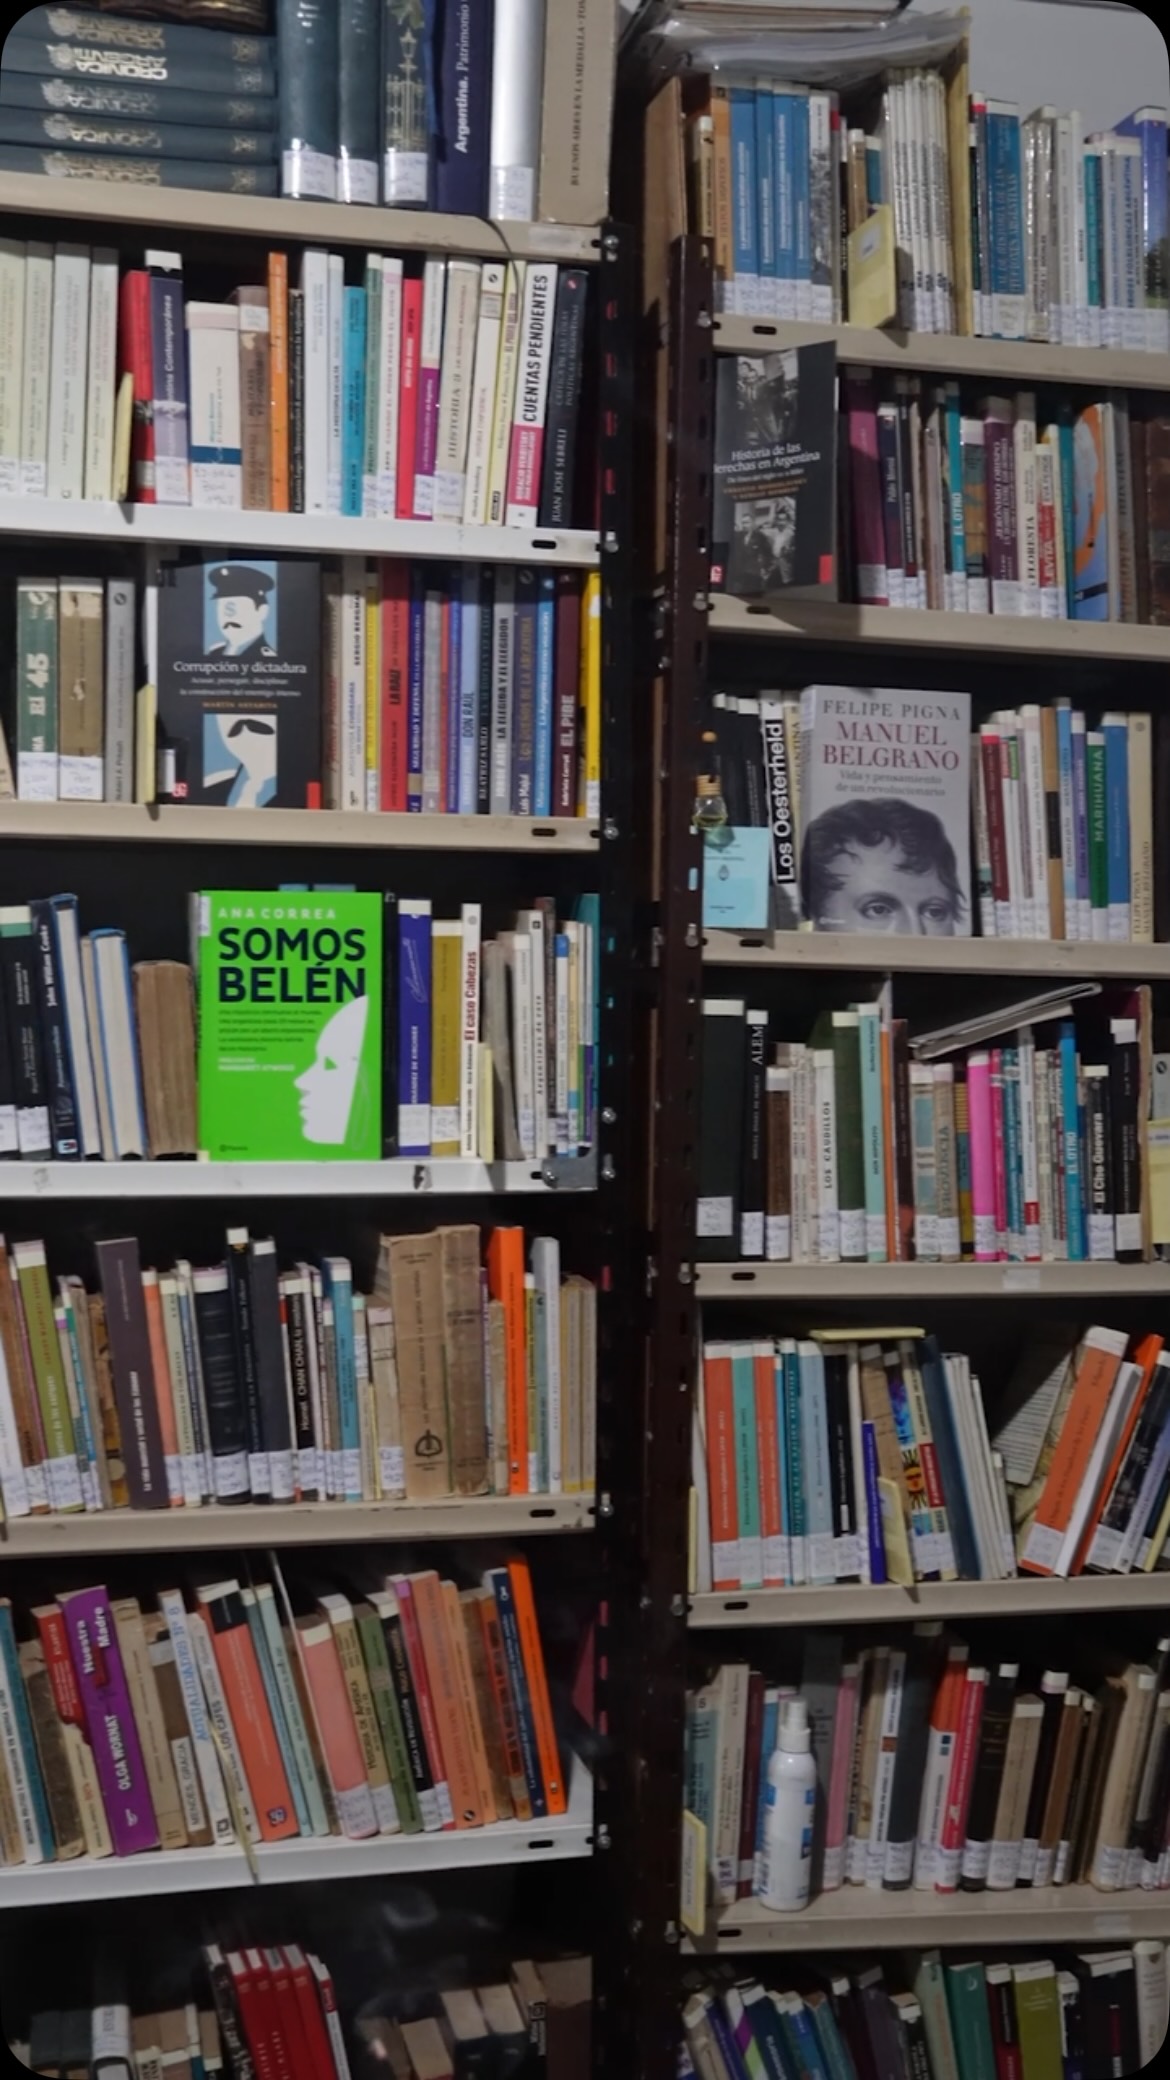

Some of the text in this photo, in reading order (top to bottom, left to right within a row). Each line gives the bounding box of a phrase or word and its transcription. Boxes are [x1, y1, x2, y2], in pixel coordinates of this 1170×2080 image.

[75, 61, 168, 79] CRONICA
[455, 5, 471, 153] Argentina. Patrimonio
[163, 295, 175, 371] Contemporánea
[522, 274, 548, 422] CUENTAS PENDIENTES
[732, 443, 801, 461] Historia de las
[758, 459, 771, 468] en
[773, 452, 821, 468] Argentina
[552, 428, 567, 522] JUAN JOSÉ SEBRELI
[952, 493, 963, 535] EL OTRO
[1026, 516, 1035, 579] FLORESTA
[498, 617, 509, 663] ELEGIDOR
[173, 661, 307, 675] Corrupción y dictadura
[497, 666, 508, 676] EL
[29, 696, 46, 716] El
[496, 687, 507, 725] ELEGIDA
[561, 695, 575, 727] PIBE
[823, 700, 961, 721] FELIPE PIGNA
[462, 717, 474, 738] DON
[480, 726, 488, 757] SARLO
[496, 727, 506, 739] LA
[560, 729, 573, 747] EL
[836, 720, 948, 746] MANUEL
[822, 744, 959, 770] BELGRANO
[519, 774, 531, 797] Majul
[835, 782, 946, 797] de un revolucionario
[839, 770, 942, 784] Vida y pensamiento
[519, 798, 529, 815] Luis
[766, 723, 794, 881] Los Oesterheld
[1092, 749, 1105, 842] MARIHUANA
[1133, 872, 1141, 900] PIGNA
[218, 908, 336, 920] ANA CORREA
[218, 927, 367, 962] SOMOS
[39, 924, 58, 1006] John William Cooke
[219, 961, 366, 1003] BELÉN
[464, 952, 477, 1041] El caso Cabezas
[752, 1025, 763, 1065] ALEM
[411, 1060, 418, 1070] DE
[823, 1101, 832, 1188] LOS CAUDILLOS
[1066, 1132, 1078, 1175] EL OTRO
[1093, 1113, 1105, 1203] El Che Guevara
[298, 1369, 307, 1395] CHAN
[169, 1605, 180, 1616] 8
[93, 1606, 111, 1648] Madre
[75, 1619, 95, 1674] Nuestra
[177, 1640, 208, 1742] ACTUALIDADES
[105, 1714, 132, 1790] OLGA WORNAT
[220, 1734, 231, 1750] LOS
[177, 1741, 192, 1780] GRACIA
